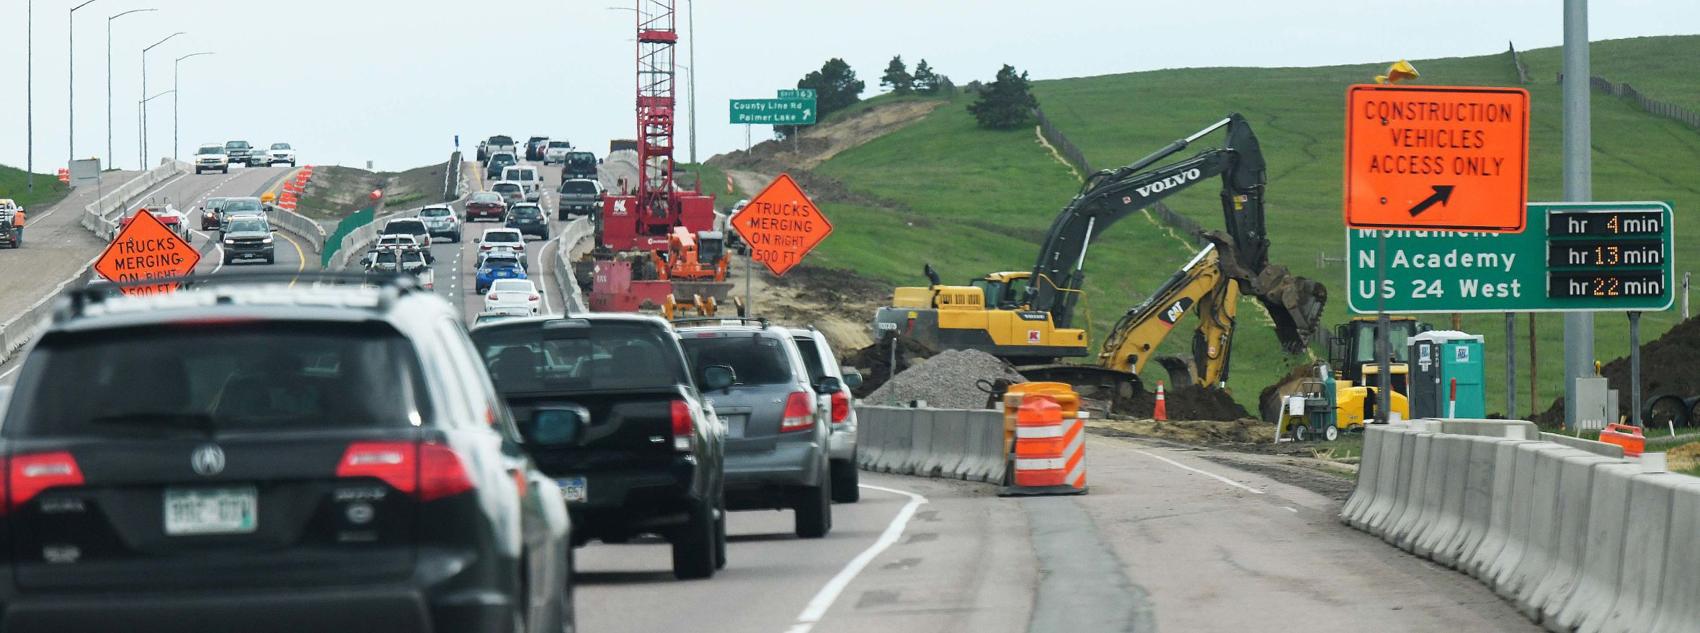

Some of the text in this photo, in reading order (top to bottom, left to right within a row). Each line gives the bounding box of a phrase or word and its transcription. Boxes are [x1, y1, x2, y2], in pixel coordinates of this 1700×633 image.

[733, 102, 802, 111] County Line Rd
[1364, 101, 1512, 123] CONSTRUCTION
[739, 113, 796, 121] Palmer Lake
[1391, 128, 1485, 149] VEHICLES
[1369, 155, 1505, 177] ACCESS ONLY
[1135, 168, 1200, 197] VOLVO
[756, 202, 810, 217] TRUCKS
[750, 218, 813, 233] MERGING
[1568, 215, 1659, 234] hr 4 min
[117, 238, 175, 254] TRUCKS
[752, 233, 804, 246] ON RIGHT
[115, 253, 180, 271] MERGING
[756, 251, 796, 263] 500 FT
[1359, 249, 1516, 272] N Academy
[1568, 246, 1660, 265] hr 13 min
[1359, 279, 1521, 299] US 24 West
[1569, 277, 1660, 296] hr 22 min
[1167, 301, 1184, 322] CAT
